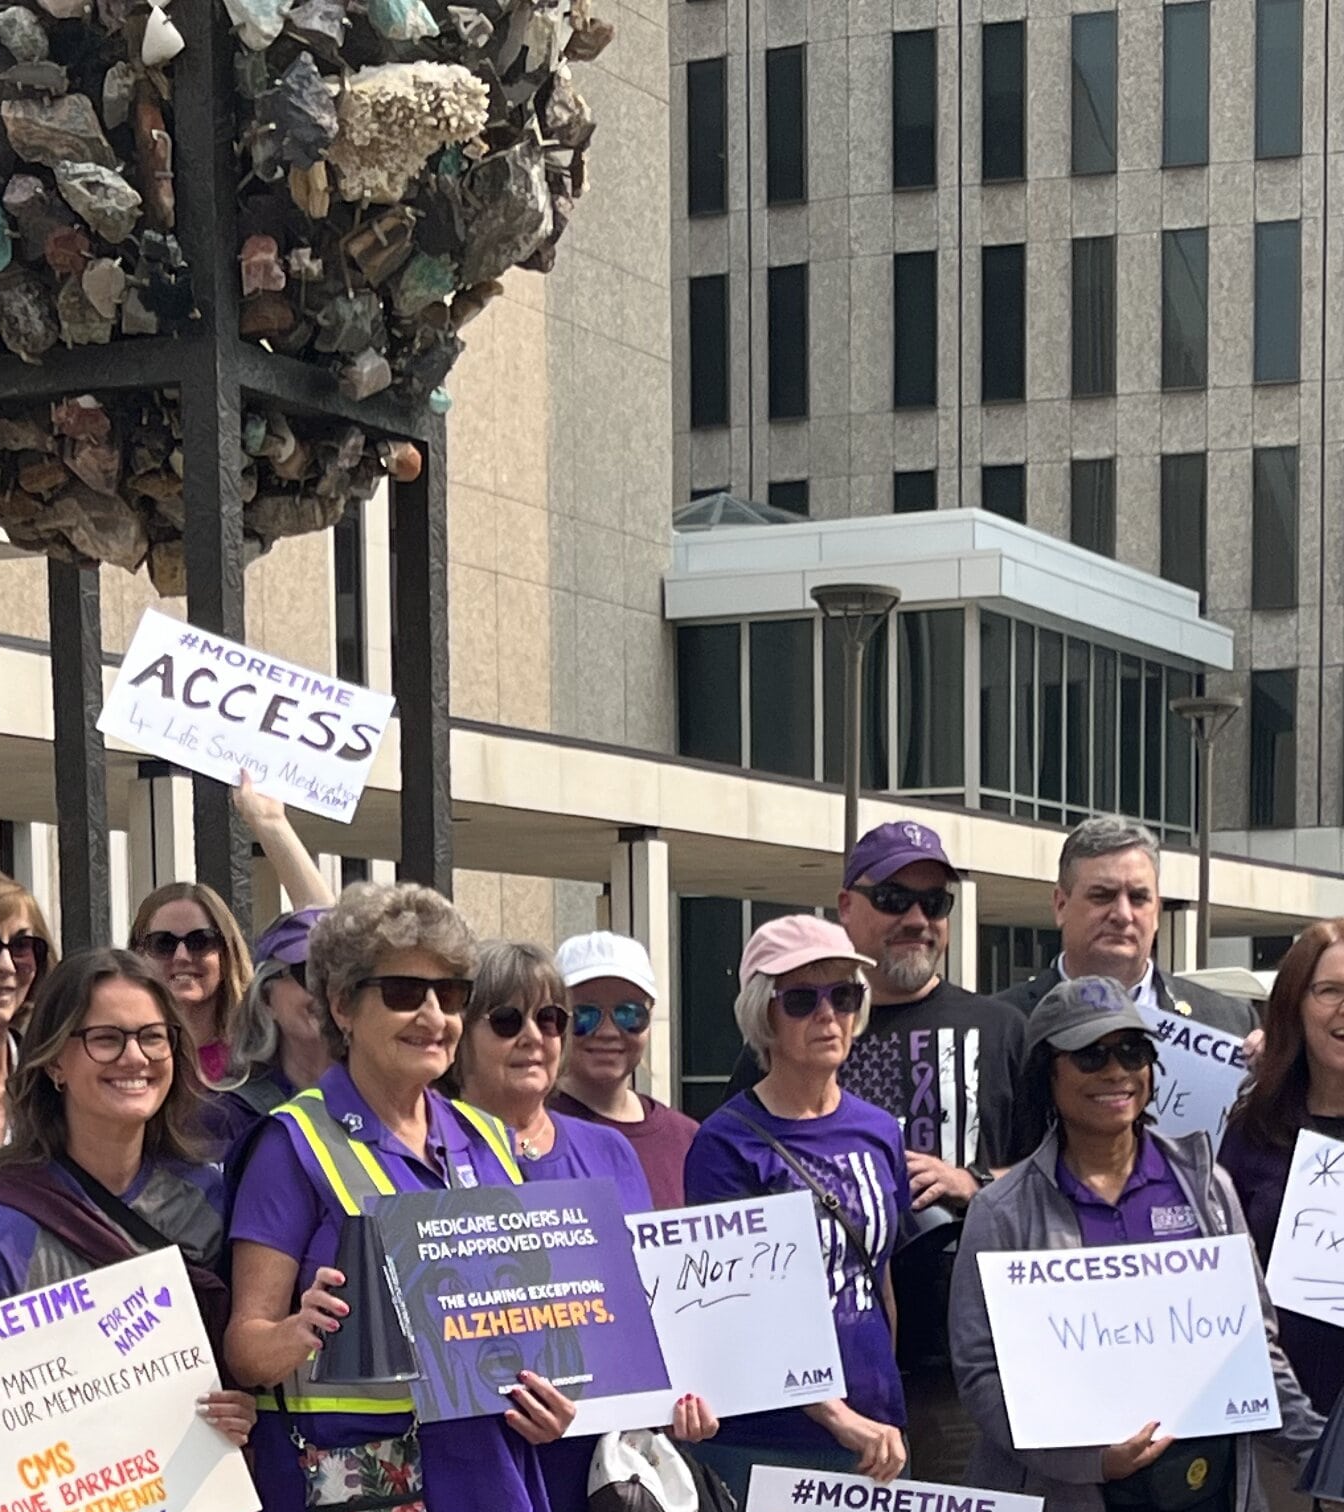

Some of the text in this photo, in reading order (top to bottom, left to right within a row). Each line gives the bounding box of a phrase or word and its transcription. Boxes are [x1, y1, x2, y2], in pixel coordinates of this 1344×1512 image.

[178, 632, 354, 707] #MORETIME
[128, 653, 381, 762] ACCESS
[205, 733, 269, 785] Saving
[416, 1207, 589, 1240] MEDICARE COVERS ALL
[417, 1228, 599, 1262] FDA-APPROVED DRUGS.
[1007, 1245, 1221, 1285] #ACCESSNOW
[437, 1279, 605, 1311] THE GLARING EXCEPTION:
[97, 1306, 128, 1338] FOR
[114, 1309, 161, 1357] NANA
[443, 1299, 616, 1342] ALZHEIMER'S.
[801, 1367, 834, 1386] AIM
[0, 1400, 44, 1434] OUR
[44, 1371, 132, 1419] MEMORIES
[1240, 1398, 1270, 1416] AIM
[16, 1439, 77, 1491] CMS
[58, 1448, 161, 1507] BARRIERS
